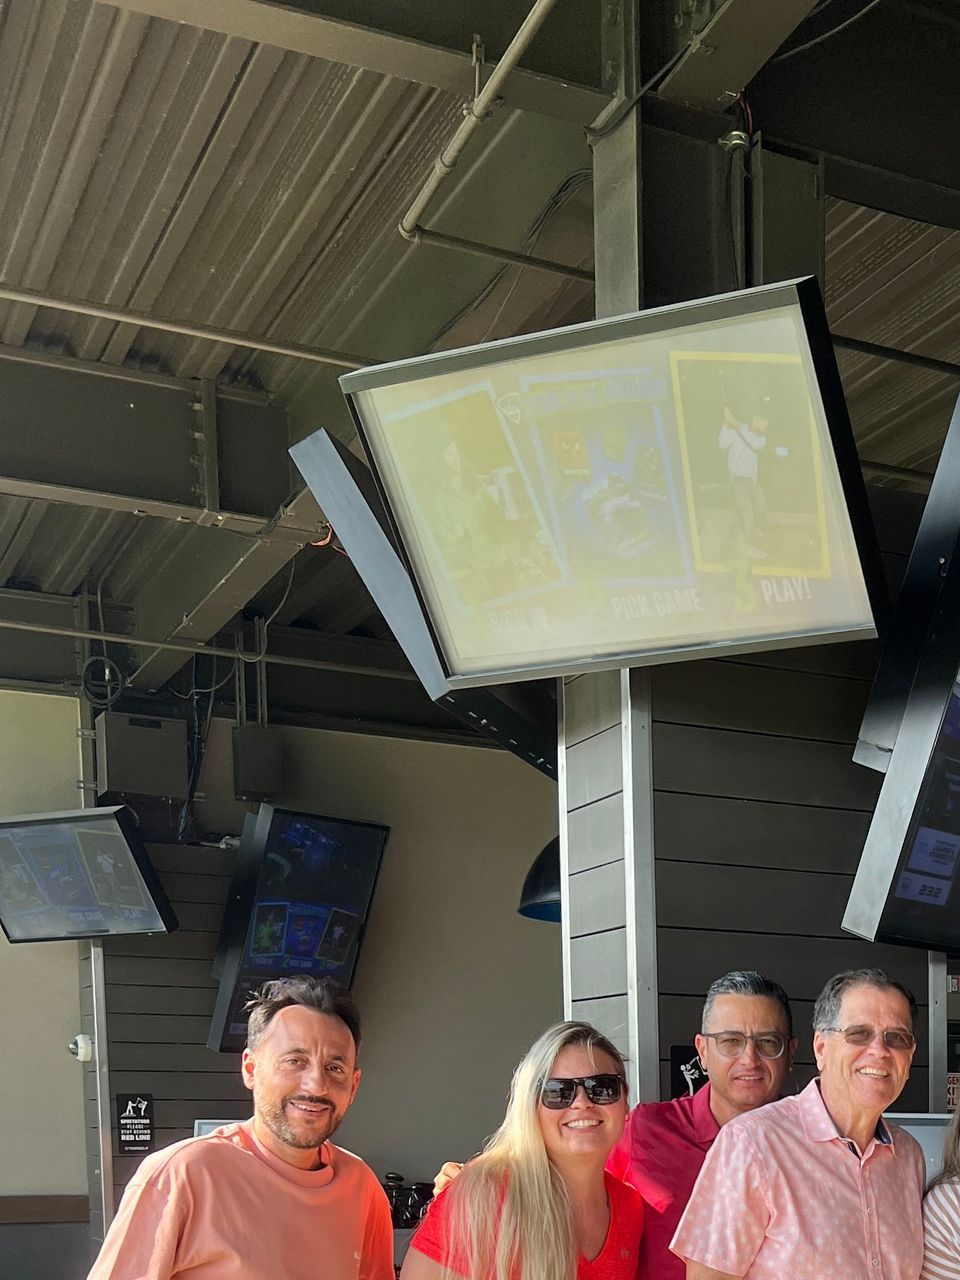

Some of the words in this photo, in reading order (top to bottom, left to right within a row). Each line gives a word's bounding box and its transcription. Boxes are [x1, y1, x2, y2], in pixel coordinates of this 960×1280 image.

[611, 590, 654, 622] PICK
[653, 588, 704, 616] GAME
[761, 576, 812, 605] PLAY!
[918, 884, 943, 898] 232
